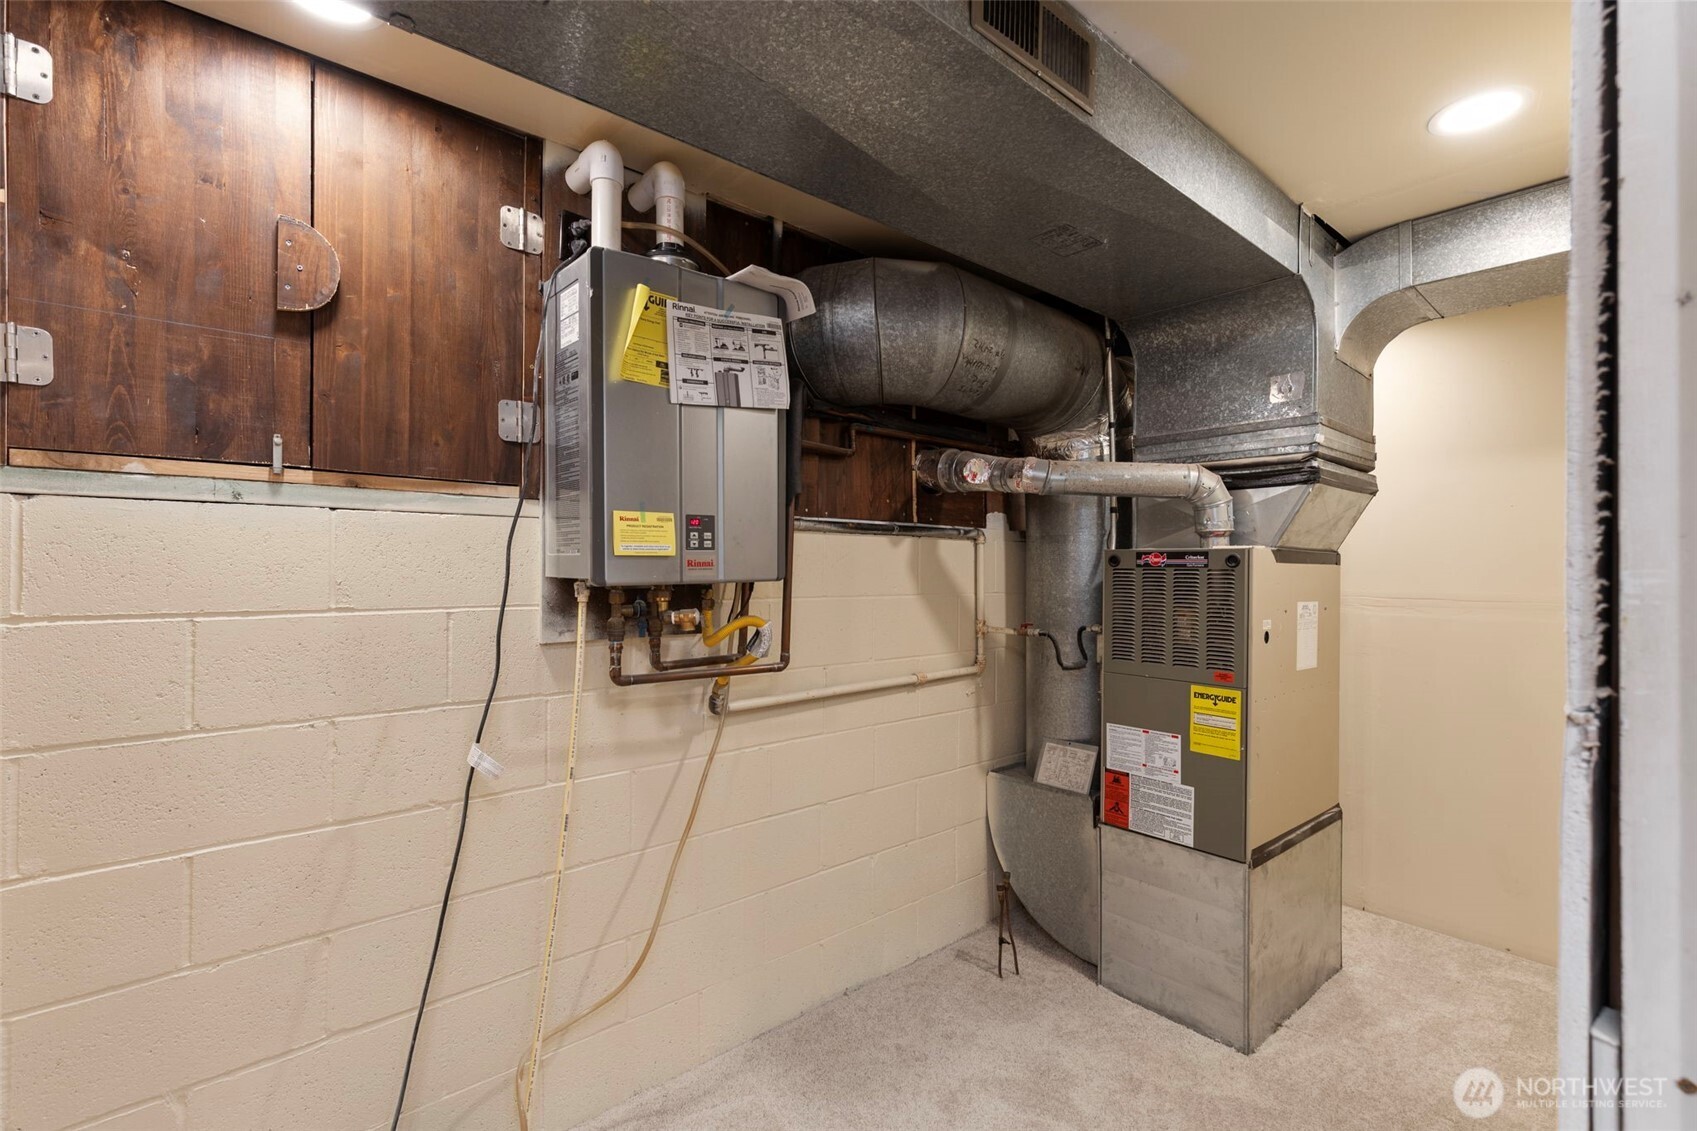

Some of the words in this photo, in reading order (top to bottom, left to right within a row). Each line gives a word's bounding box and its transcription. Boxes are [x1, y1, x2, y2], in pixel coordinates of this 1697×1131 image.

[672, 303, 696, 313] Rinnai
[687, 559, 714, 567] Rinnai
[1193, 692, 1237, 704] ENERGYGUIDE
